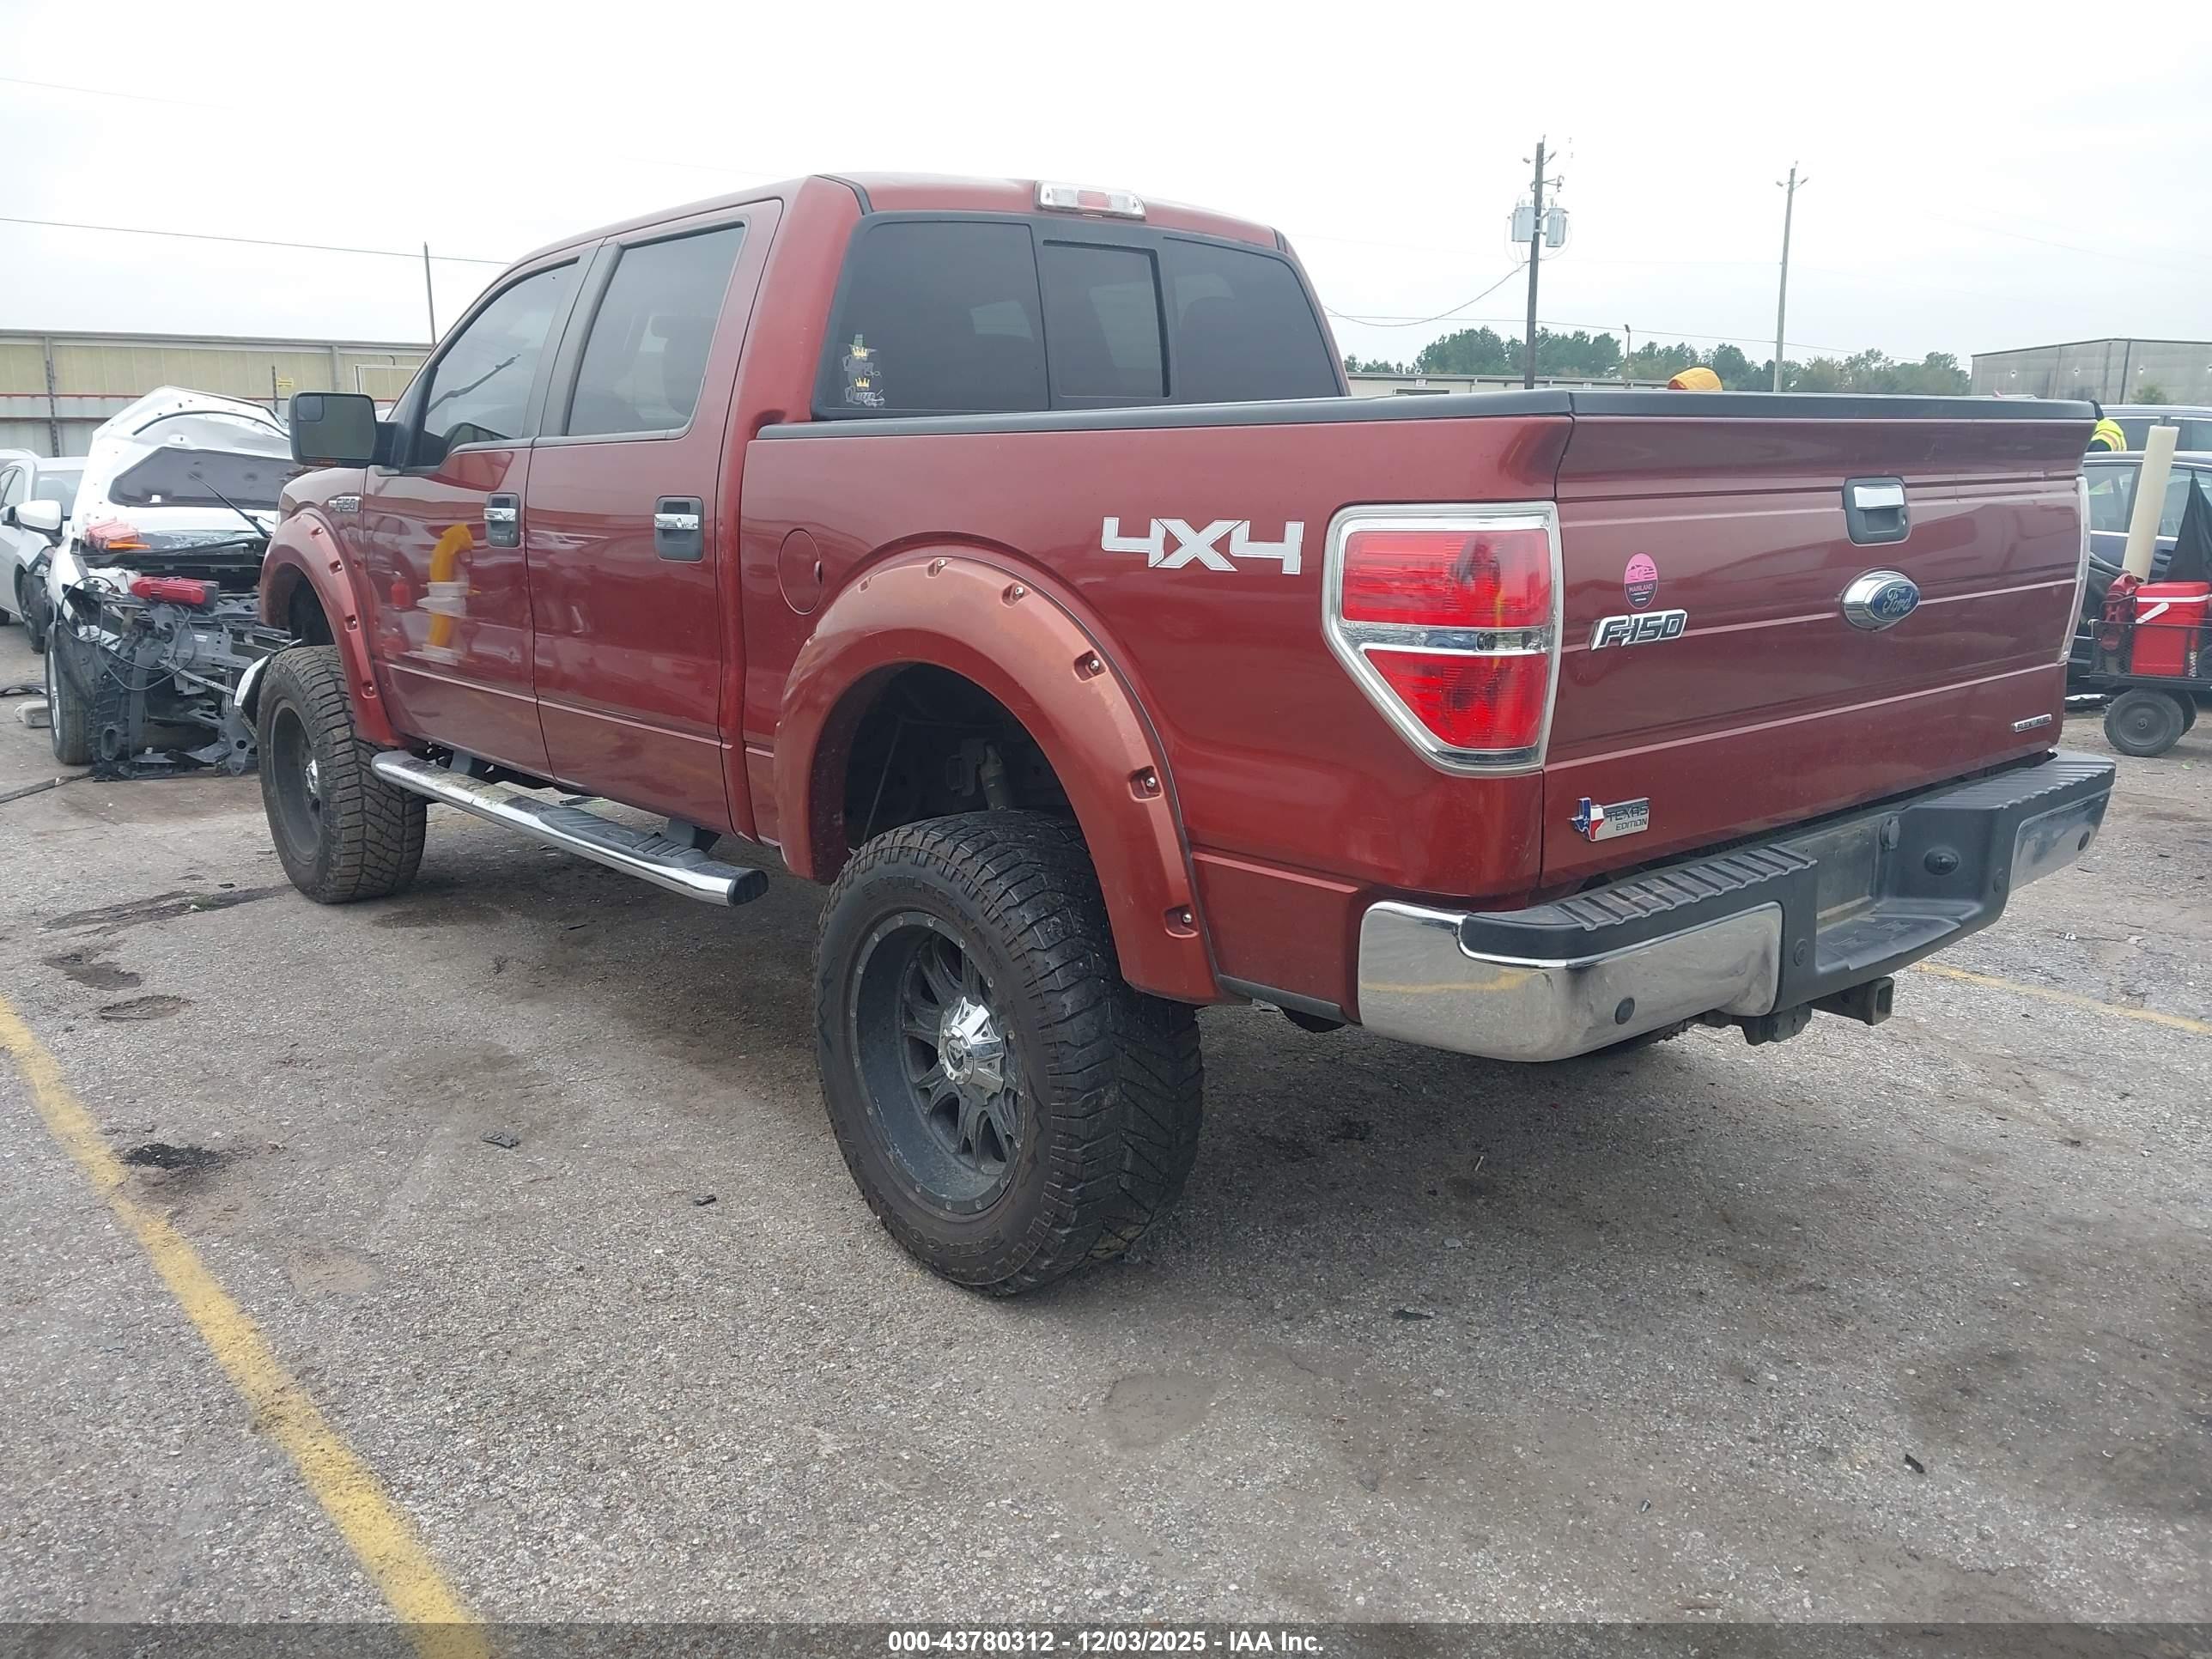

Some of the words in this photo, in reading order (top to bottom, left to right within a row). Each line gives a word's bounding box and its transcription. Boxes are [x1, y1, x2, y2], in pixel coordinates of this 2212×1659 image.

[1102, 517, 1304, 574] 4X4
[1882, 587, 1913, 613] Ford
[1591, 609, 1688, 651] F-150
[1606, 805, 1649, 822] TEXAS
[1615, 817, 1648, 831] EDITION
